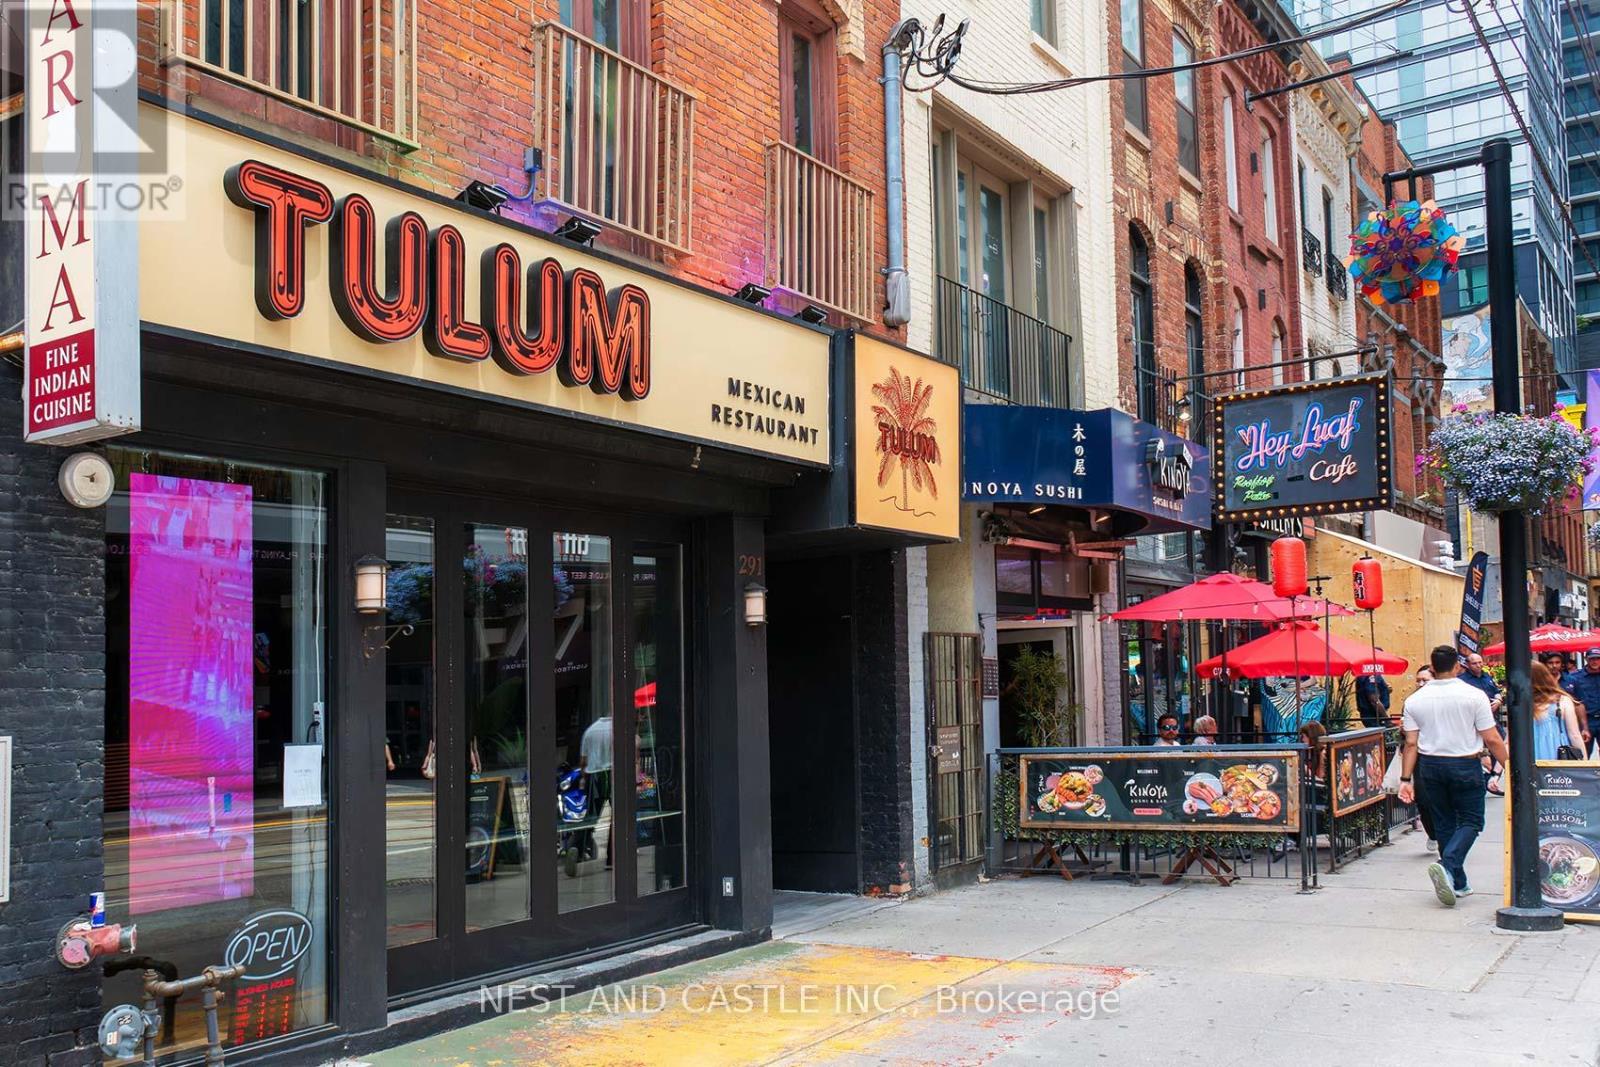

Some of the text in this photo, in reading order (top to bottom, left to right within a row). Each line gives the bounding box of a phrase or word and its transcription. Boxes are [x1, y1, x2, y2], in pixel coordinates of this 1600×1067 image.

[223, 159, 652, 402] TULUM
[46, 342, 79, 370] FINE
[35, 364, 91, 397] INDIAN
[728, 377, 805, 415] MEXICAN
[33, 391, 92, 424] CUISINE
[711, 403, 819, 446] RESTAURANT
[1236, 419, 1293, 471] Hey
[1291, 397, 1362, 459] Lucy
[878, 421, 936, 464] TULUM
[1309, 454, 1358, 484] Cafe
[1034, 484, 1083, 499] SUSHI
[739, 554, 762, 577] 291
[1129, 783, 1168, 800] KINOYA
[231, 924, 305, 966] OPEN
